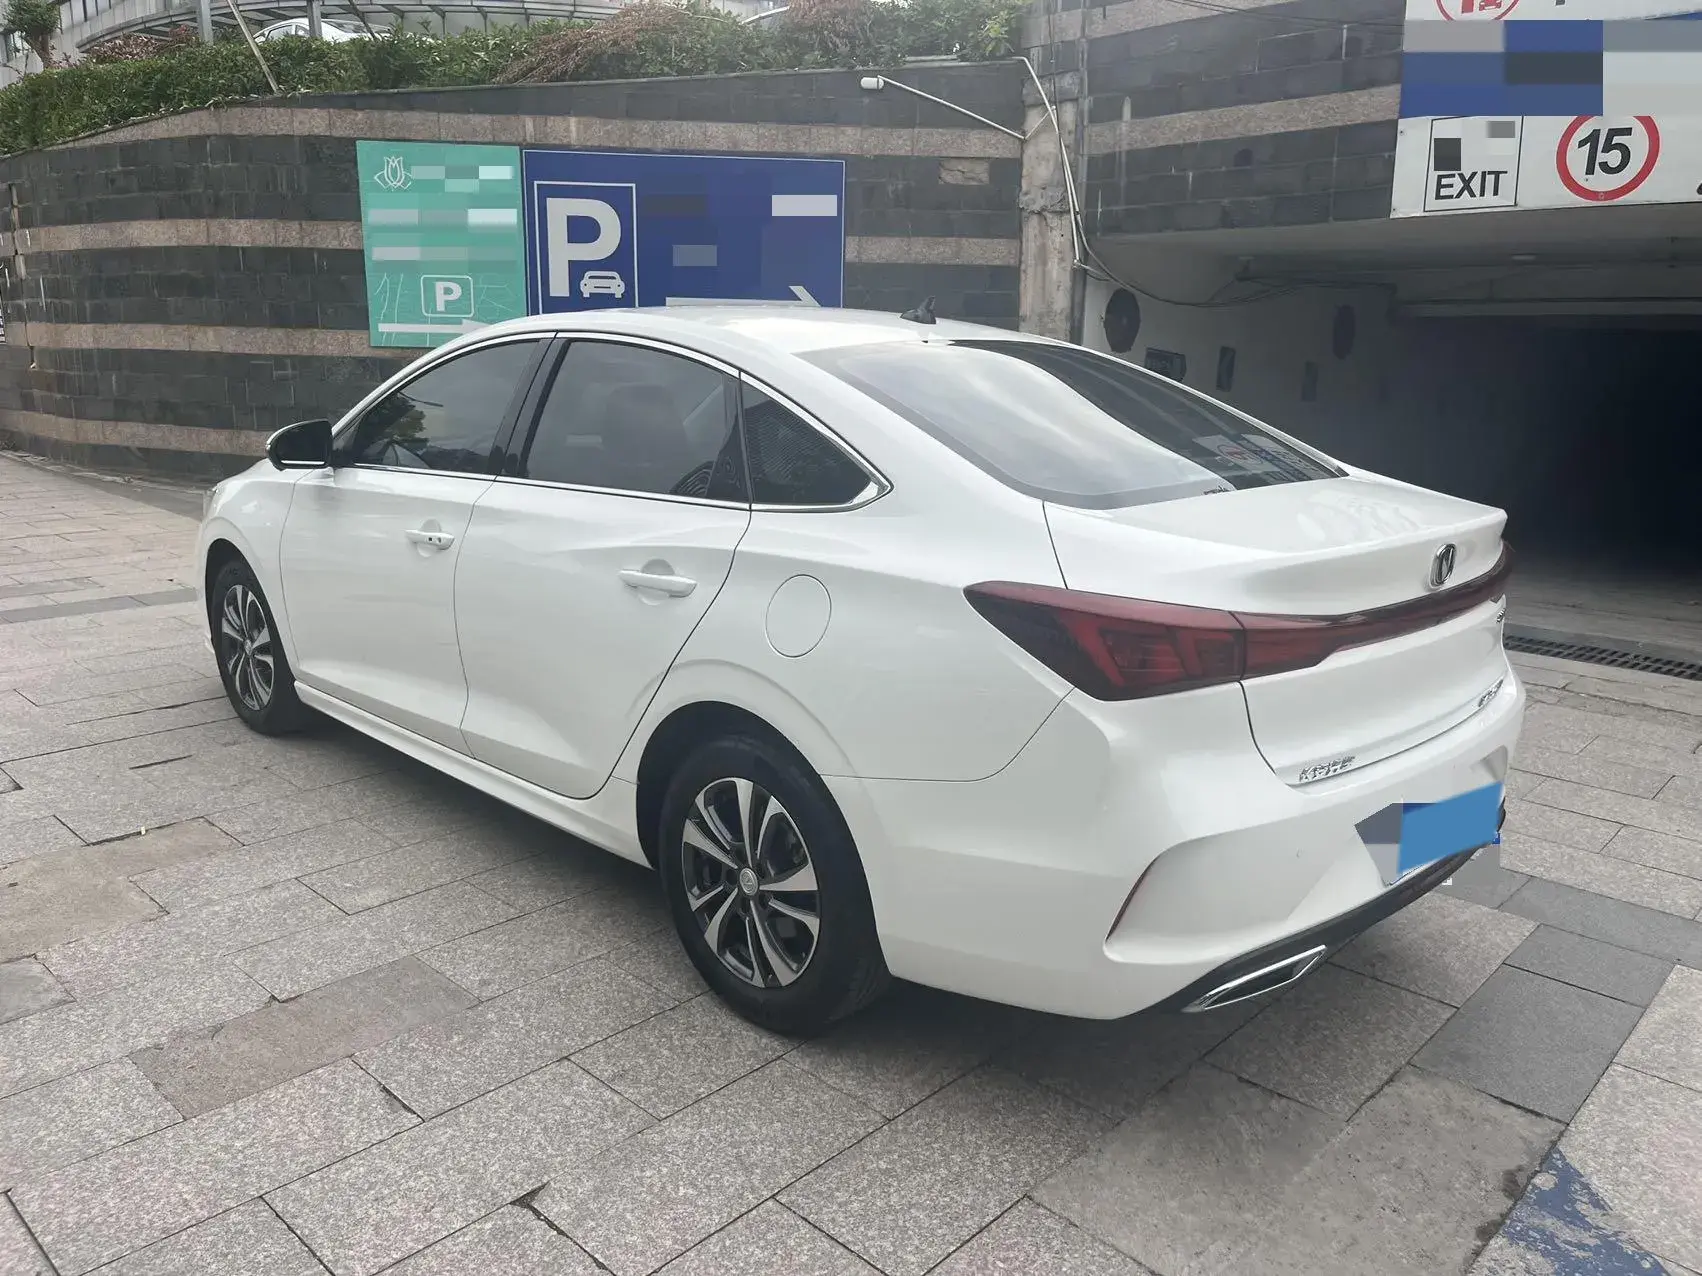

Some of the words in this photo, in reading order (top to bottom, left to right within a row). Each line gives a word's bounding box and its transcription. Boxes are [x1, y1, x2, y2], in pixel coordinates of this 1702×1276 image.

[1577, 127, 1633, 176] 15
[1434, 170, 1508, 200] EXIT
[547, 197, 622, 297] P
[434, 281, 463, 312] P
